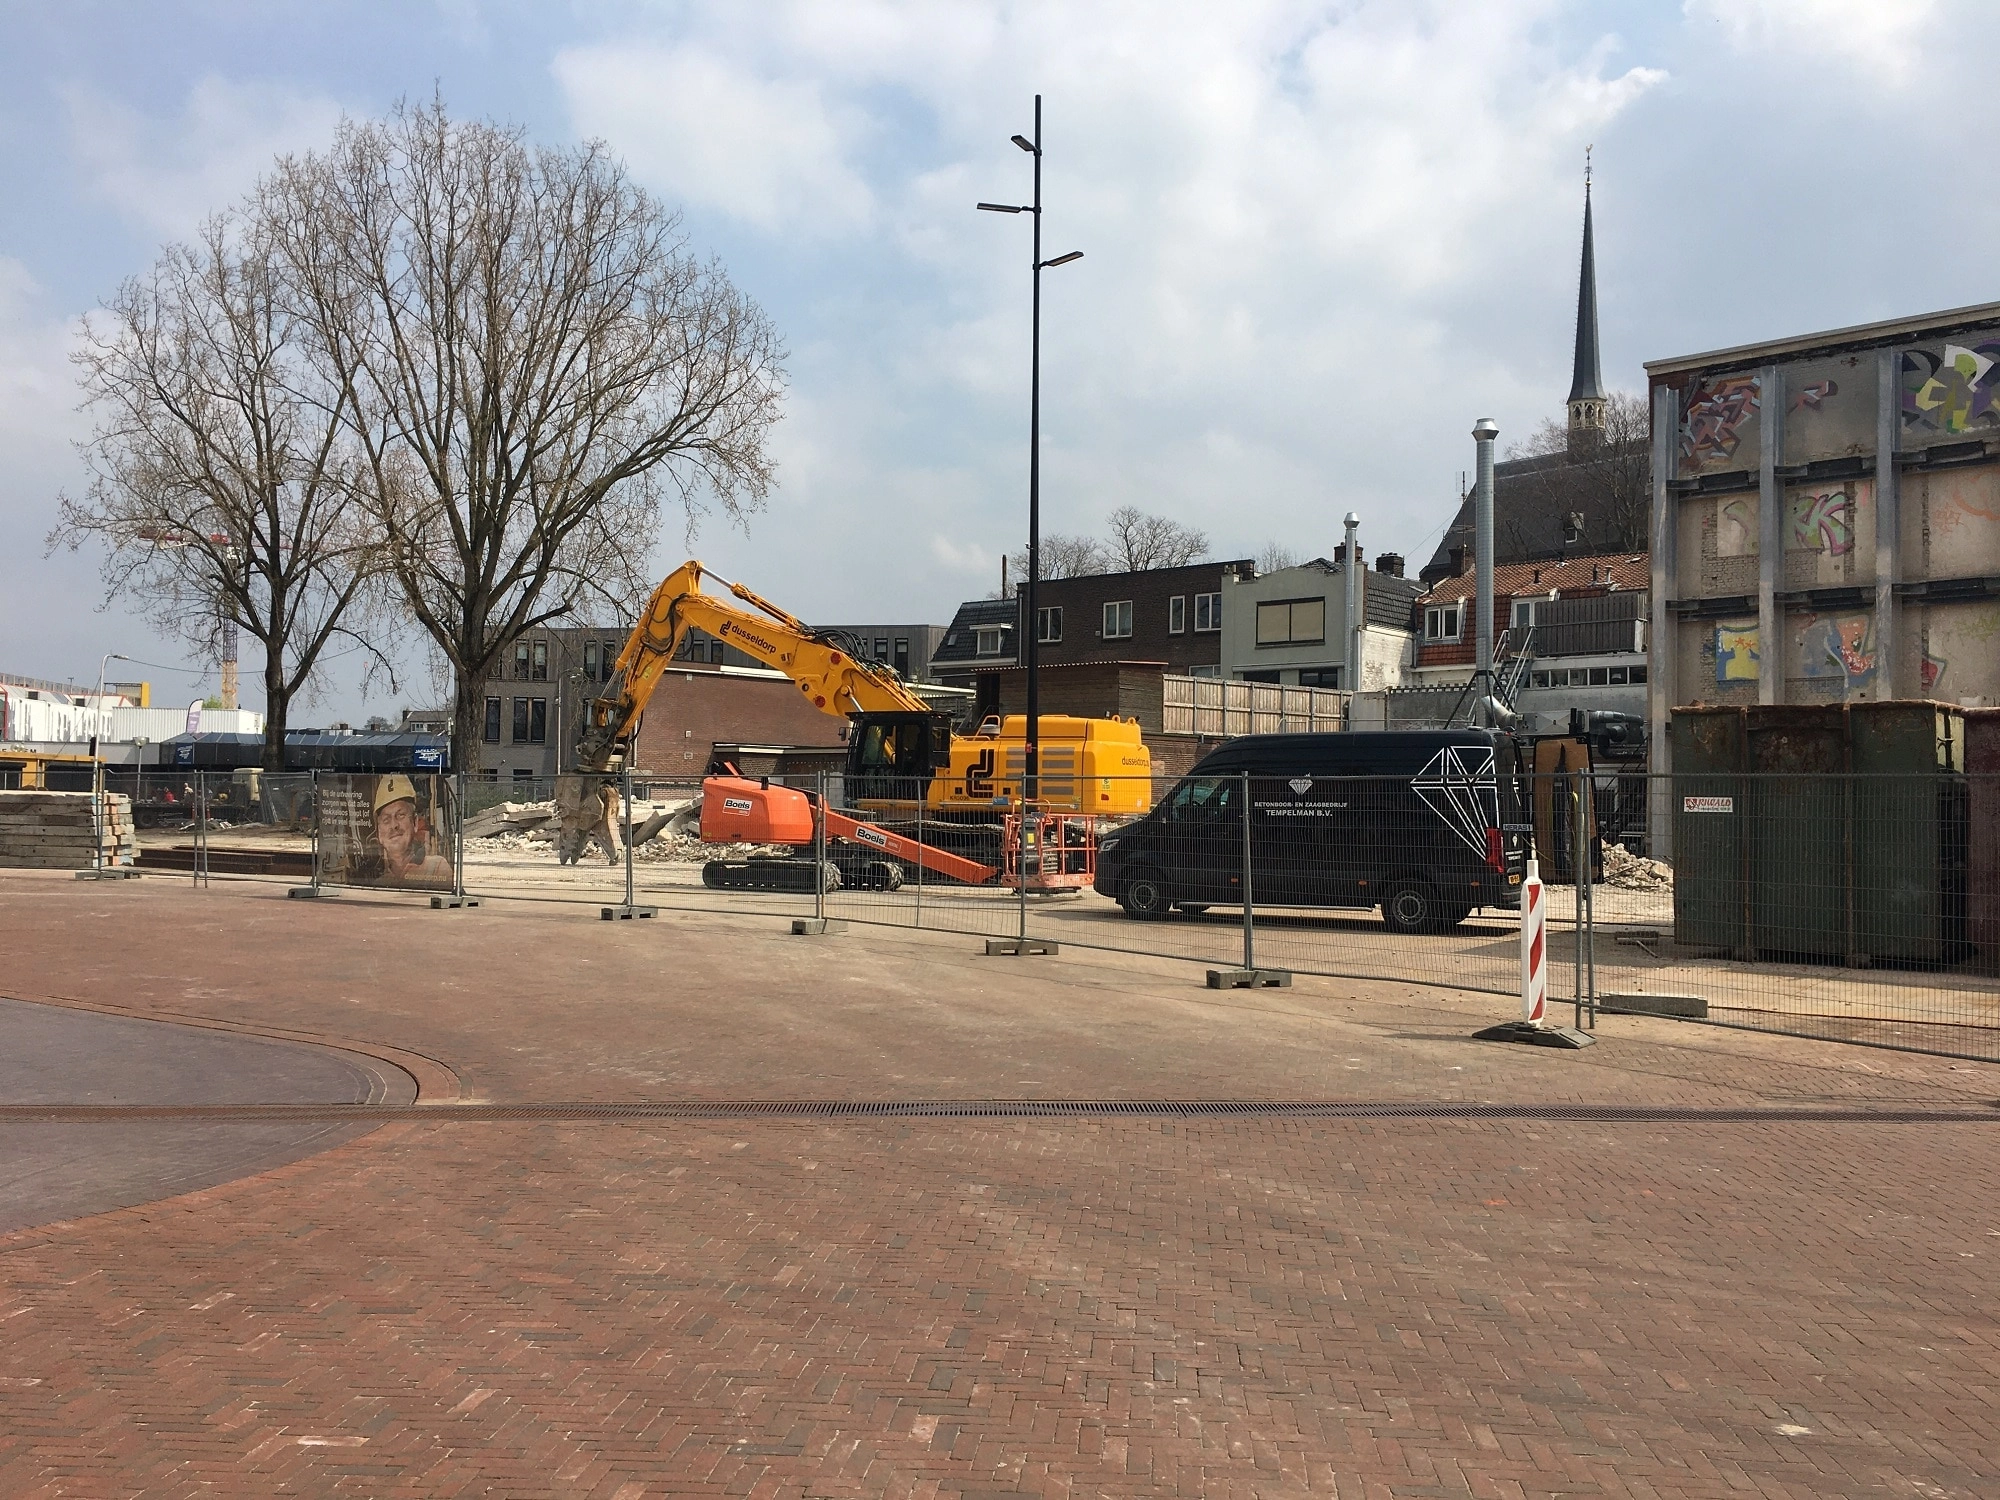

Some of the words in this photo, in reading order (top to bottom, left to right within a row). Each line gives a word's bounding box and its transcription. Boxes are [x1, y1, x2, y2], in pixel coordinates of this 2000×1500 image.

[731, 624, 777, 654] dusseldorp
[725, 800, 750, 809] Boels
[1699, 798, 1732, 807] RIWALD
[1266, 809, 1315, 817] TEMPELMAN
[857, 828, 885, 845] Boels
